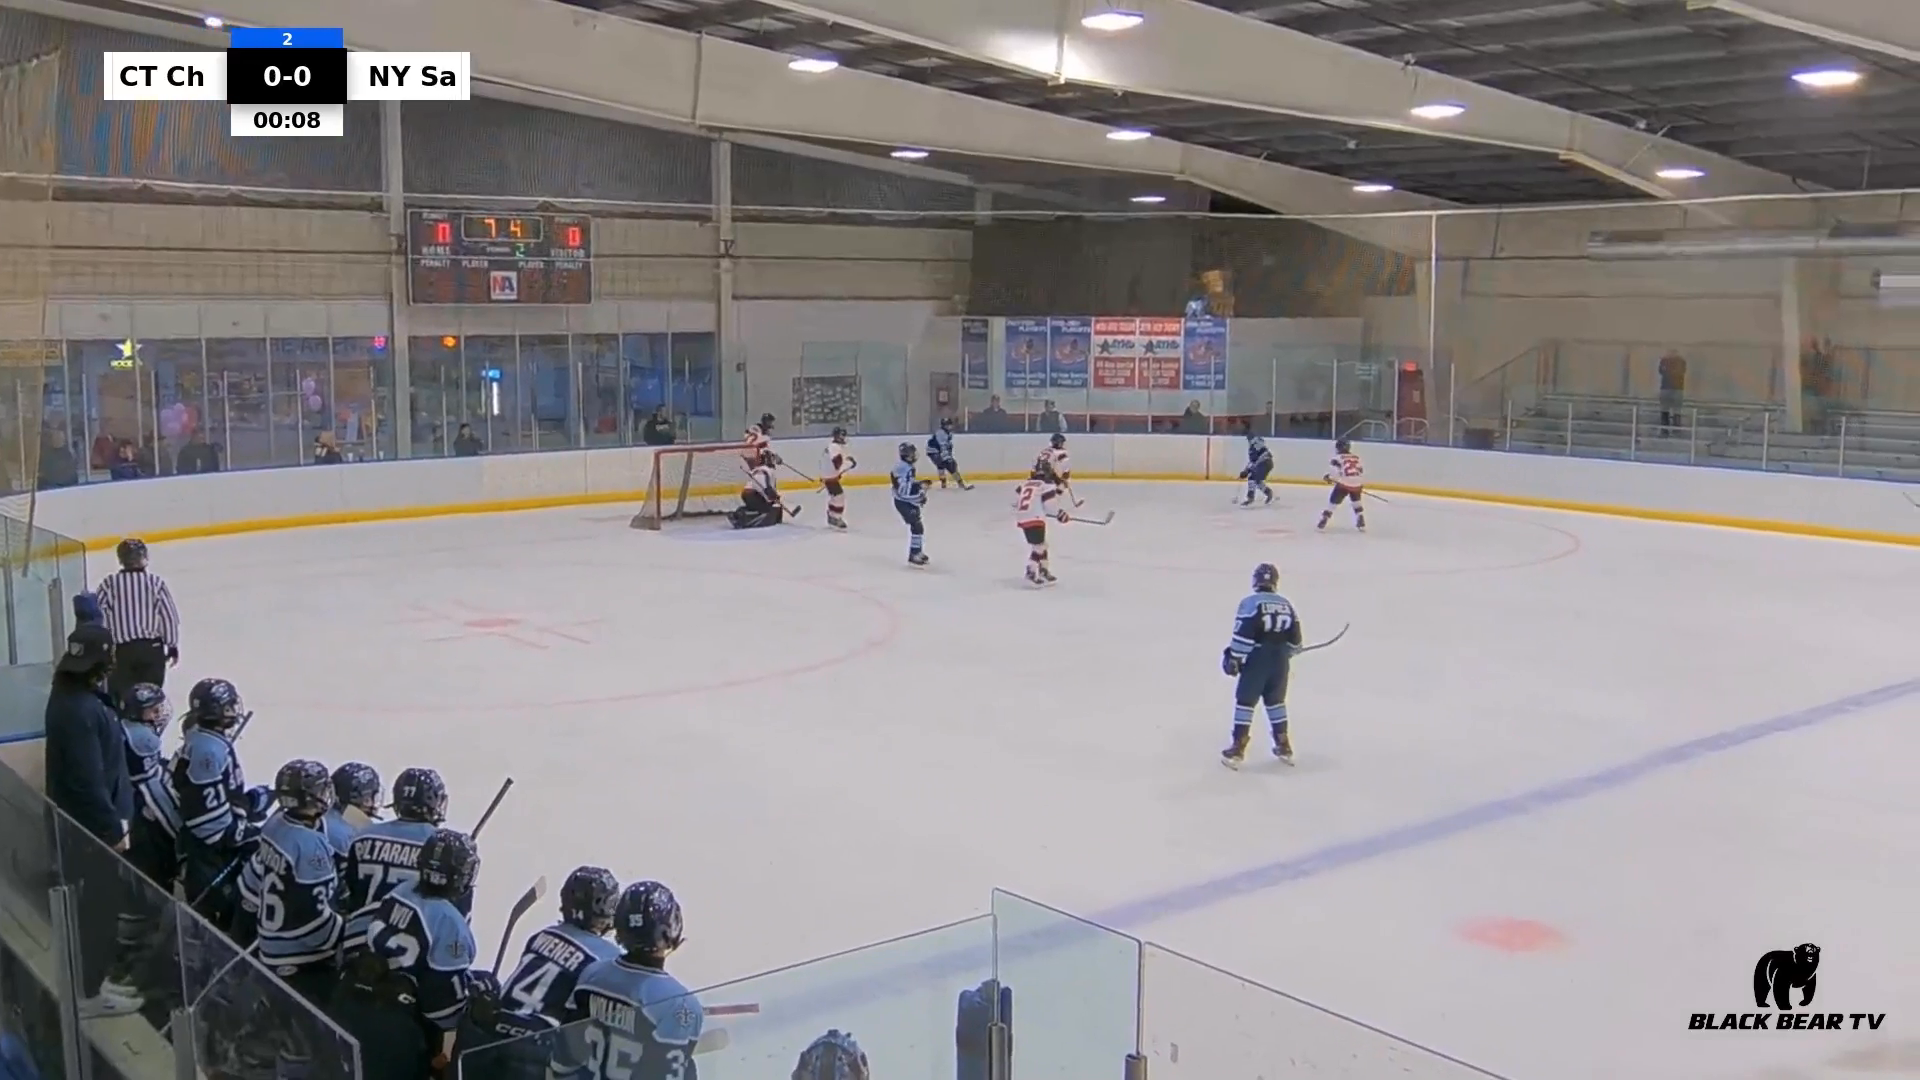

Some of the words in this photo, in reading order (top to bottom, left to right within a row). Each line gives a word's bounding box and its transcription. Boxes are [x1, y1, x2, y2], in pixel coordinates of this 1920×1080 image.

[203, 783, 226, 809] 21
[403, 786, 417, 797] 77
[388, 902, 414, 930] WU
[530, 931, 585, 972] WIENER
